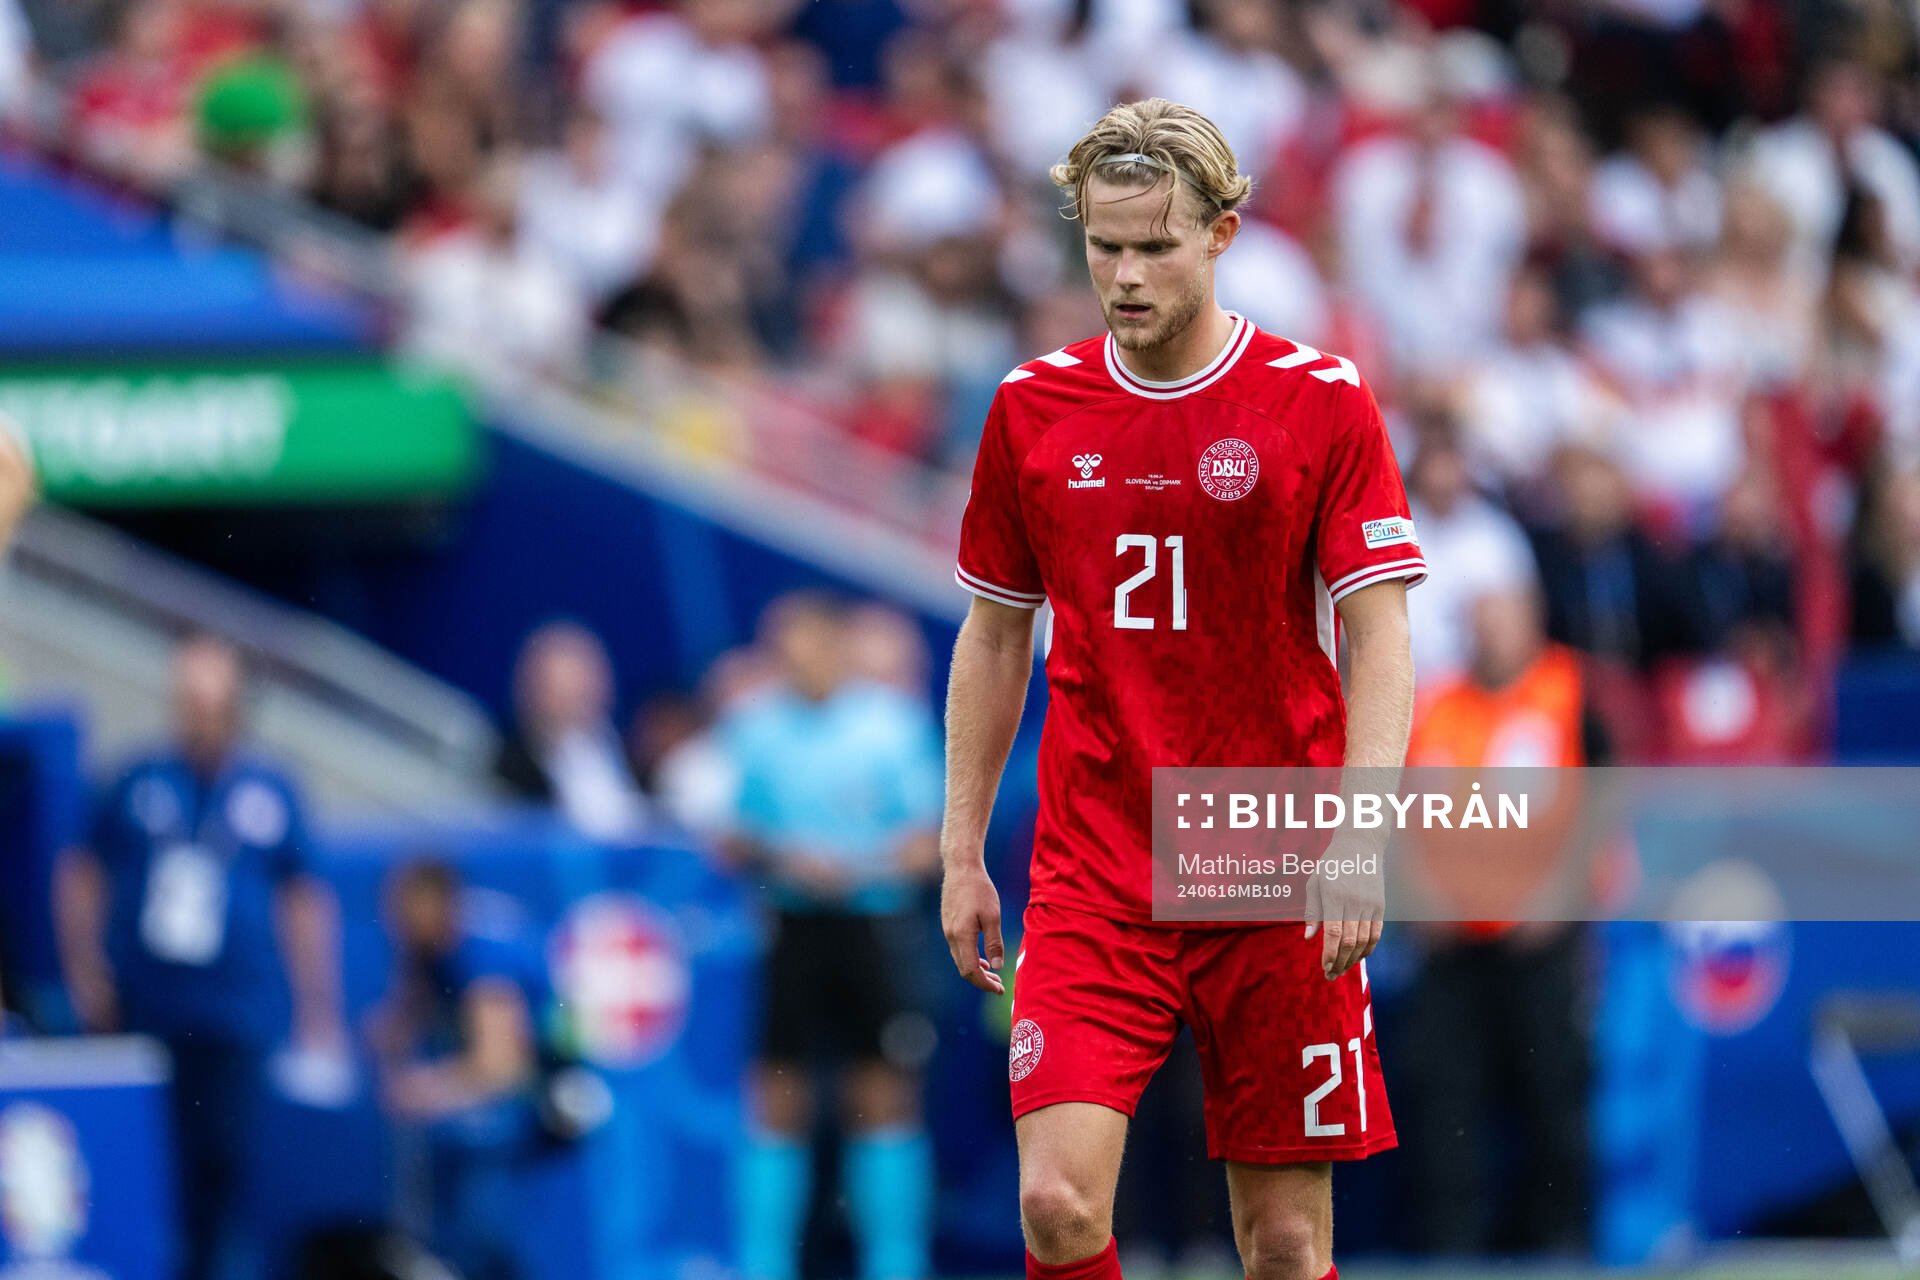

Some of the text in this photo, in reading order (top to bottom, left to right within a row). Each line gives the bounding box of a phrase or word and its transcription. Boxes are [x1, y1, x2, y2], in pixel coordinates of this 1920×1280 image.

[1201, 455, 1215, 491] DANSK
[1211, 458, 1246, 478] DBU
[1242, 457, 1257, 491] UNION
[1068, 477, 1105, 489] hummel
[1216, 490, 1241, 499] 1889
[1365, 521, 1382, 530] UEFA
[1114, 533, 1187, 631] 21
[1302, 1037, 1367, 1137] 21
